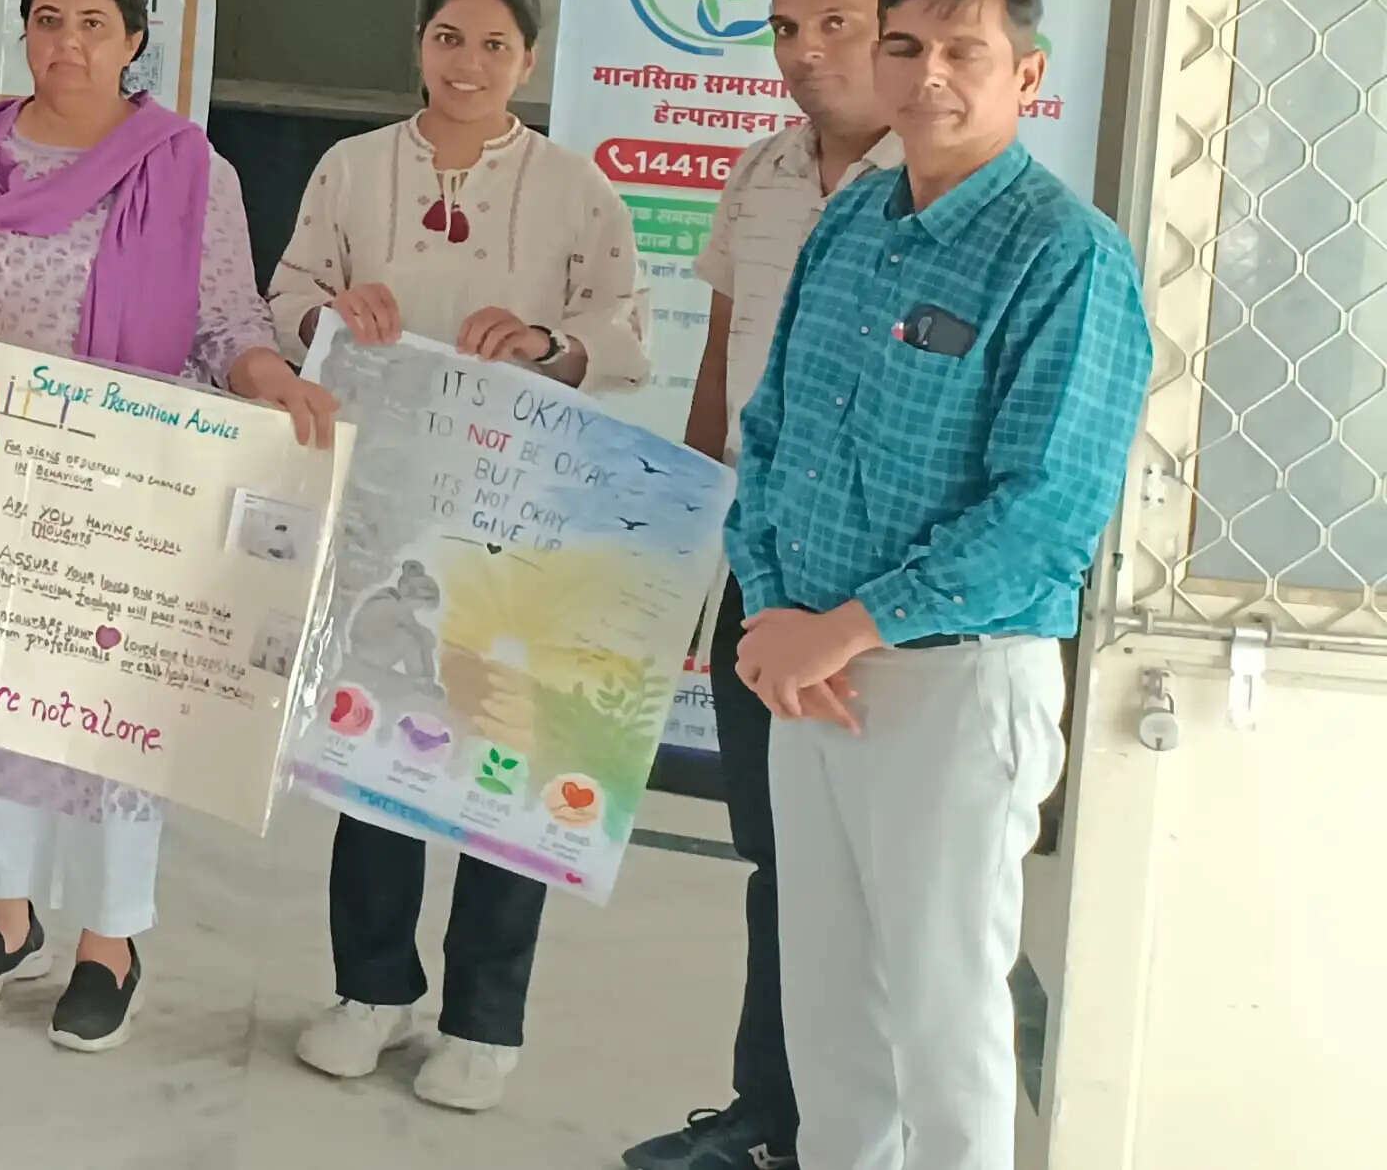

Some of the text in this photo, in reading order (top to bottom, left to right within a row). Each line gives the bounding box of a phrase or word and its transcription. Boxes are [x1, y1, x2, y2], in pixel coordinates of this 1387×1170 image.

[593, 64, 700, 92] मानसिक
[653, 99, 779, 134] हेल्पलाइन
[634, 150, 732, 181] 14416
[513, 388, 597, 432] OKAY
[426, 410, 454, 437] TO
[467, 422, 513, 454] NOT
[519, 440, 547, 465] BE
[473, 457, 527, 491] BUT
[37, 505, 74, 527] YOU
[85, 513, 132, 539] HAVING
[430, 494, 455, 518] TO
[472, 510, 526, 543] GIVE
[474, 487, 511, 511] NOT
[520, 501, 571, 534] OKAY
[31, 691, 76, 728] not
[80, 699, 163, 753] alone
